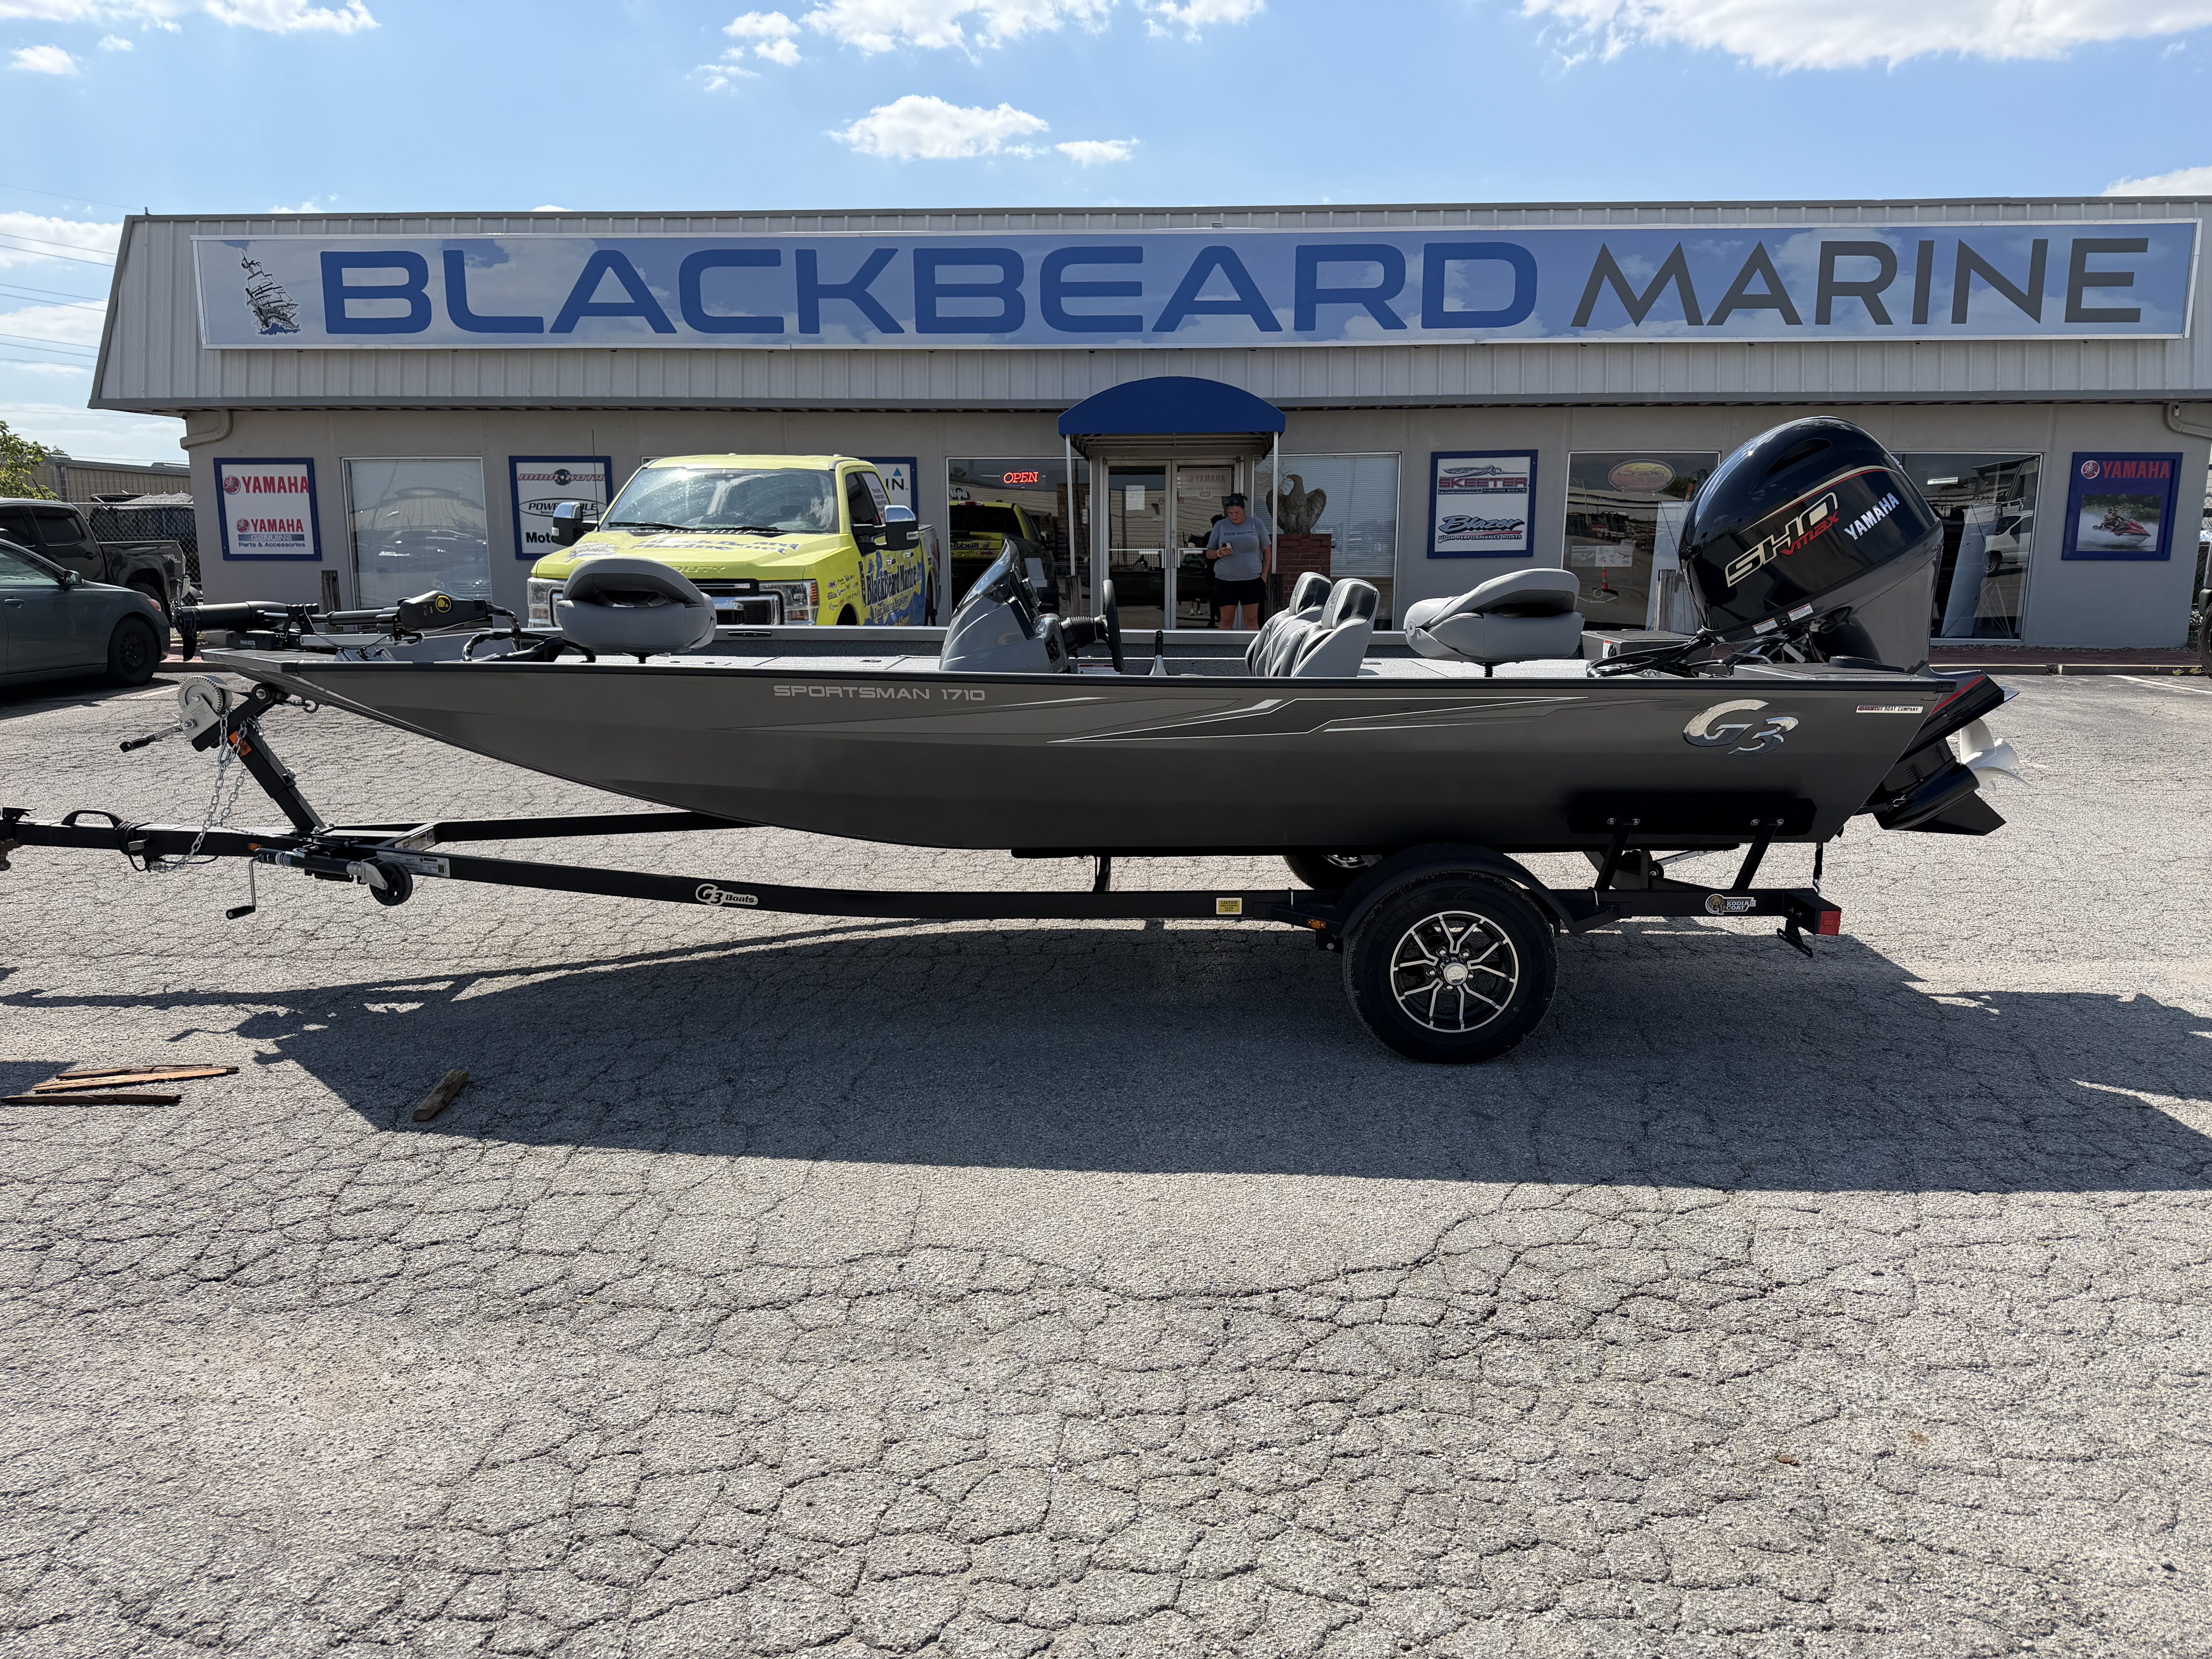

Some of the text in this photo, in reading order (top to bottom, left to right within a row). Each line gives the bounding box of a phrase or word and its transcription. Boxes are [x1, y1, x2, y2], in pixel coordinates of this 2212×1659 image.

[321, 238, 2148, 334] BLACKBEARD MARINE
[1003, 471, 1039, 484] OPEN
[1195, 474, 1225, 483] YAMAHA
[2103, 461, 2170, 479] YAMAHA
[241, 476, 309, 493] YAMAHA
[1439, 477, 1528, 488] SKEETER
[1439, 515, 1525, 534] Blazer
[1844, 492, 1899, 540] YAMAHA
[251, 519, 304, 532] YAMAHA
[1724, 492, 1838, 588] SHO
[773, 685, 986, 701] SPORTSMAN 1710
[1682, 699, 1799, 756] G3
[697, 886, 754, 904] G3 Boats
